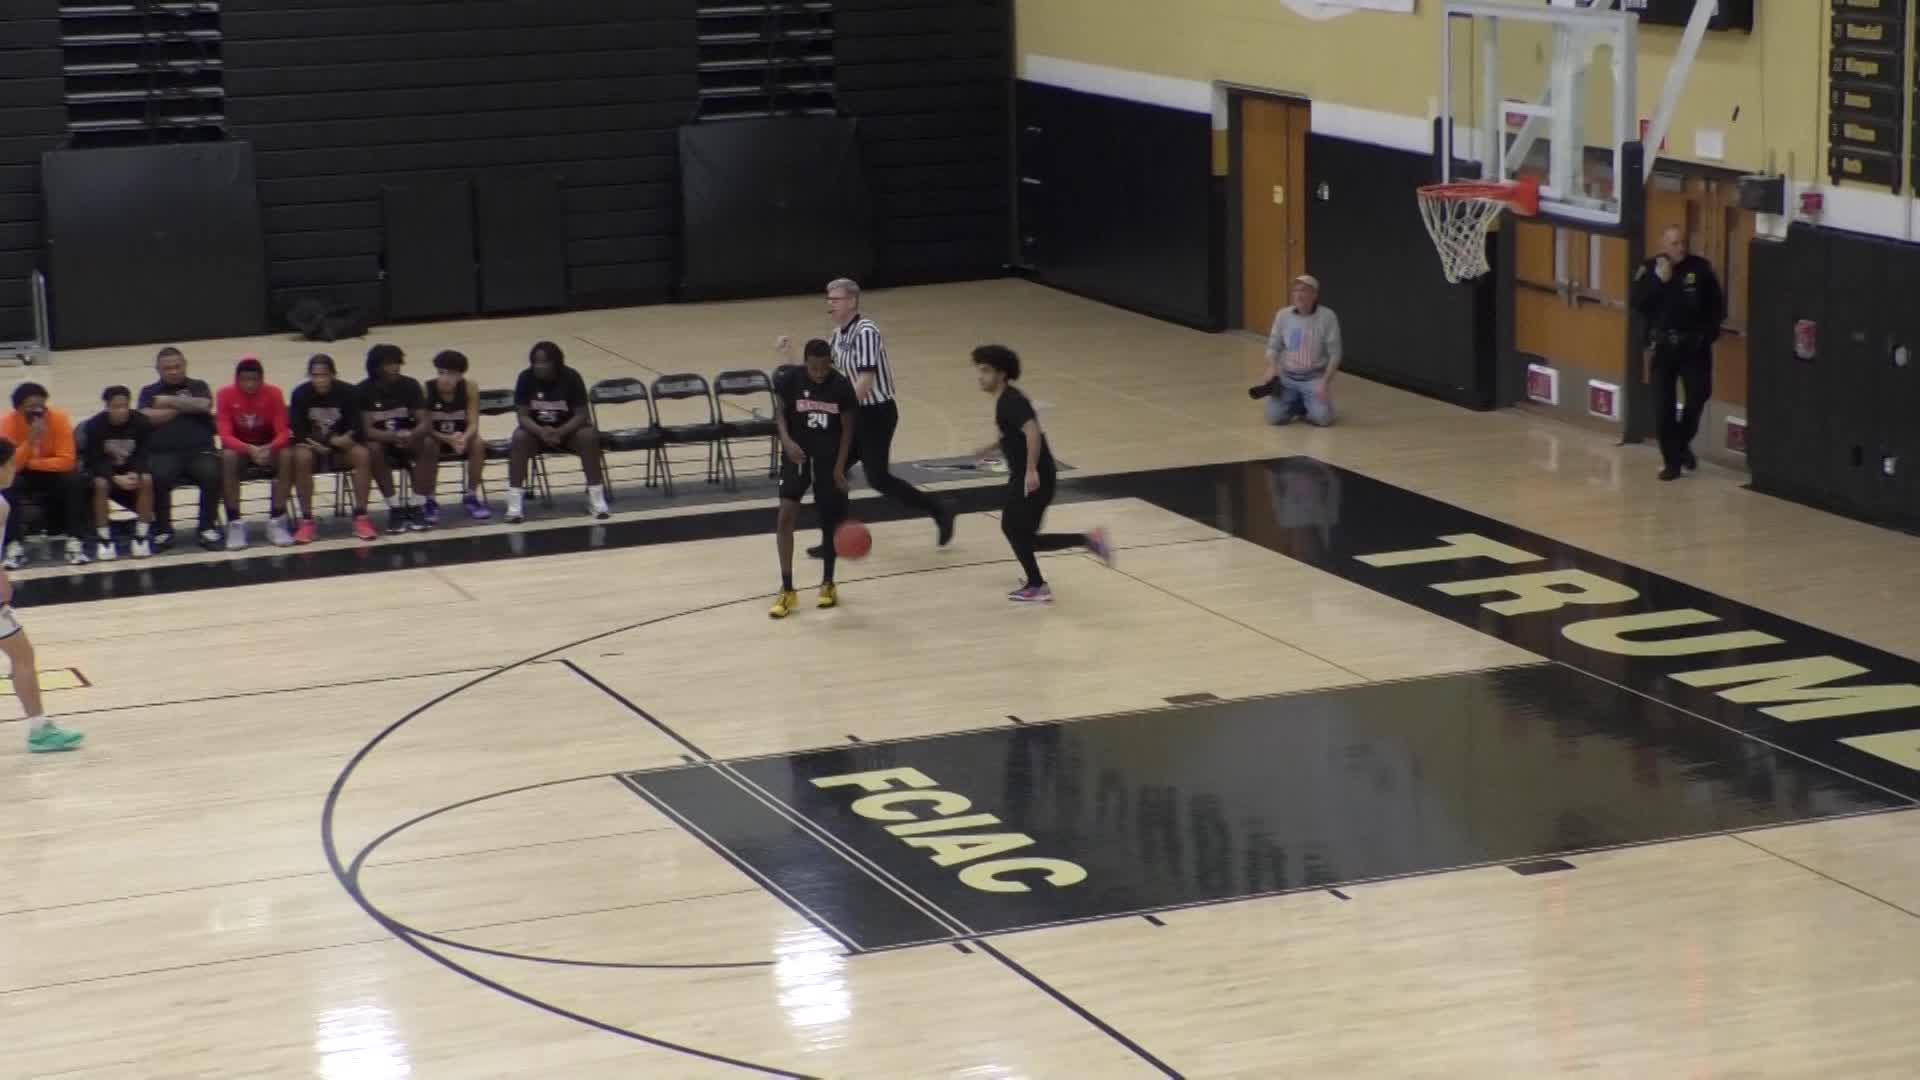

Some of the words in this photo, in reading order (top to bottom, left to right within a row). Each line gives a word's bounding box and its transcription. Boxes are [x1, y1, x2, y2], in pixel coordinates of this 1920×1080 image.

[807, 412, 828, 429] 24
[1352, 532, 1920, 771] TRUM
[808, 766, 1088, 894] FCIAC
